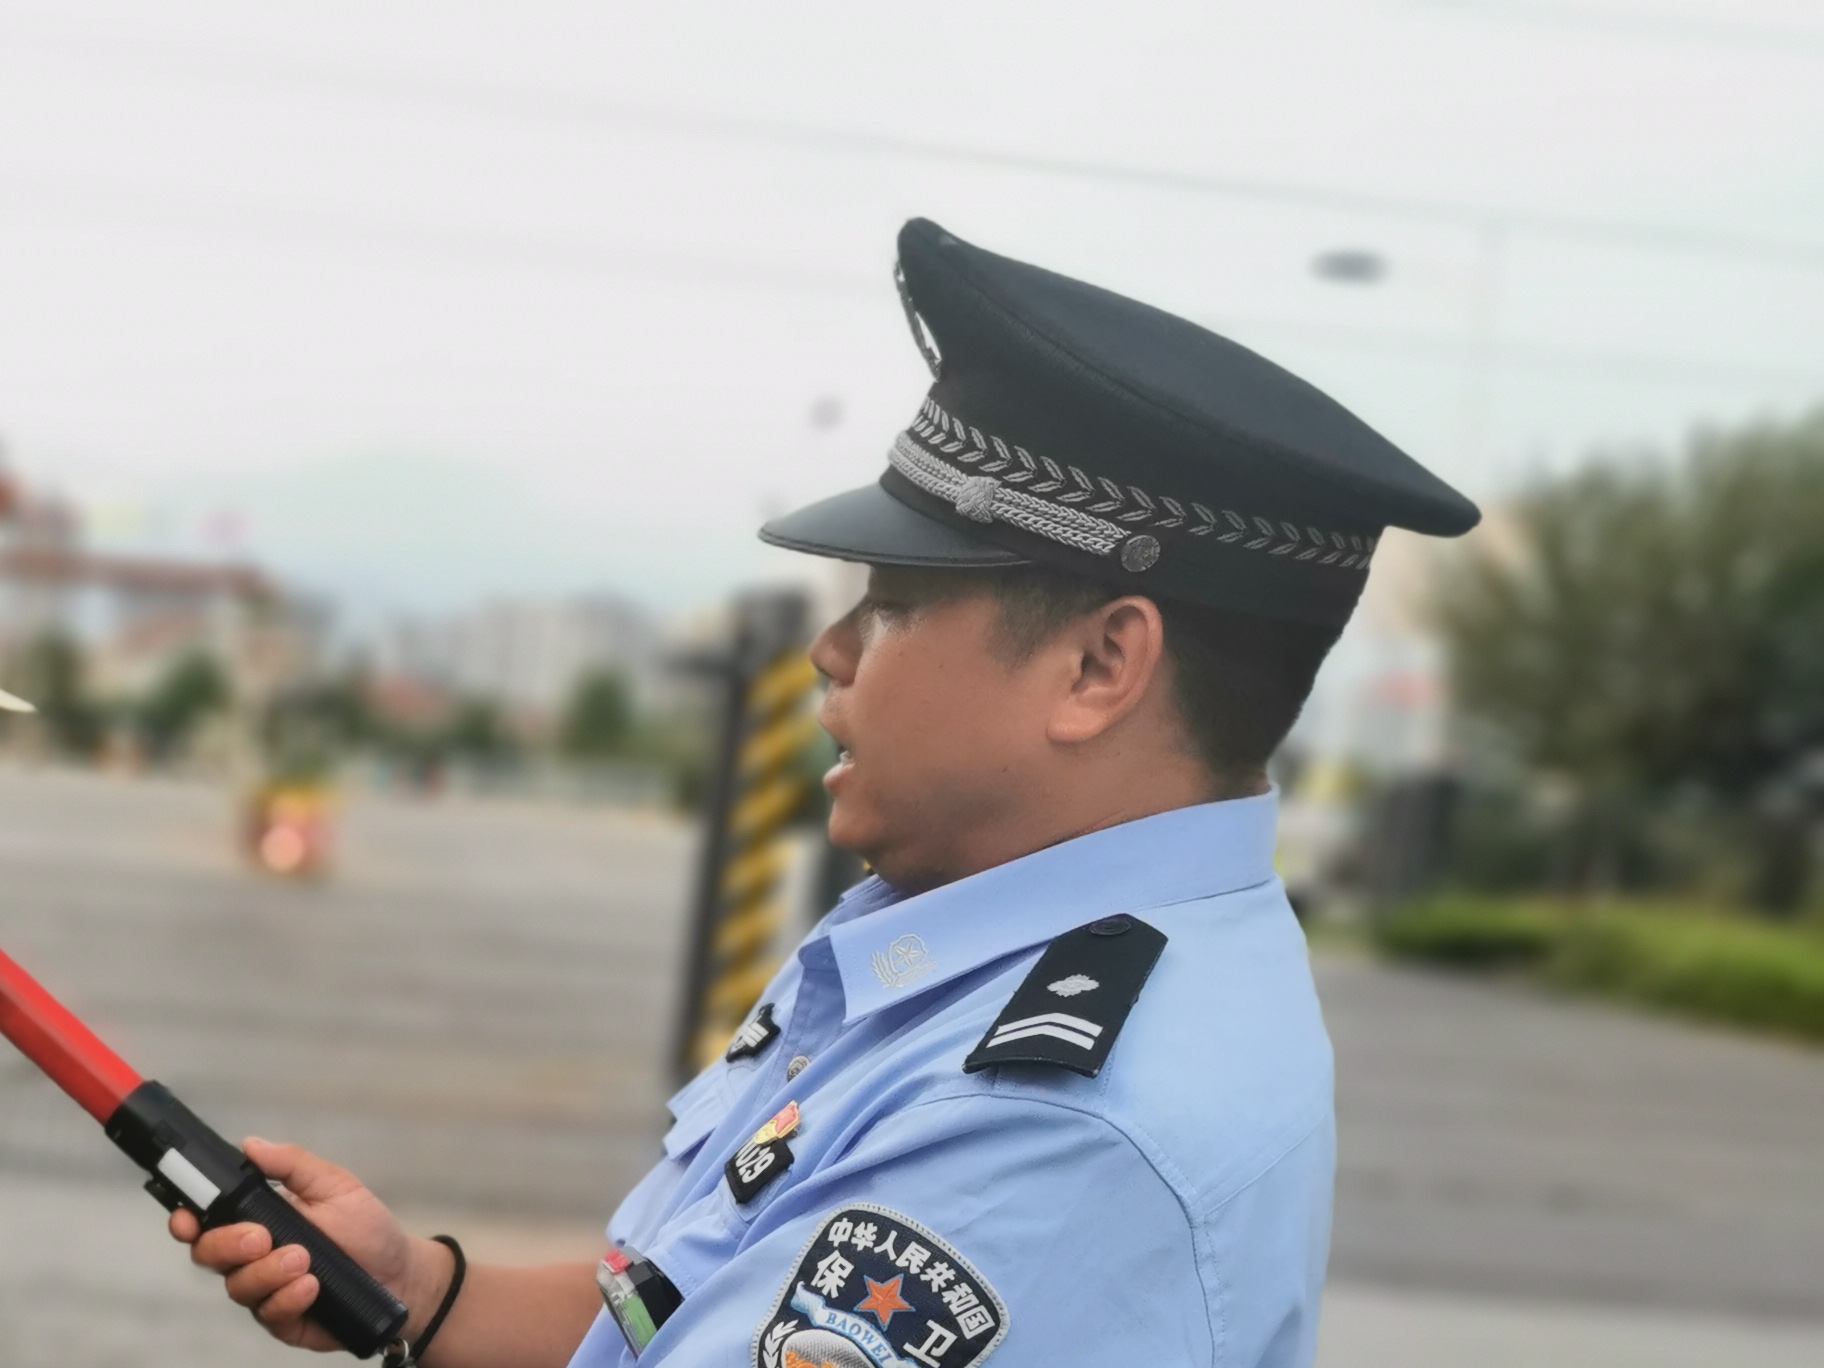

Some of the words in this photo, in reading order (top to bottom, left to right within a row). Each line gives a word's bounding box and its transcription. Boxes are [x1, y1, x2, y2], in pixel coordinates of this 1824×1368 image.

[827, 1217, 995, 1340] 中华人民共和国
[826, 1312, 896, 1364] BAOWEI
